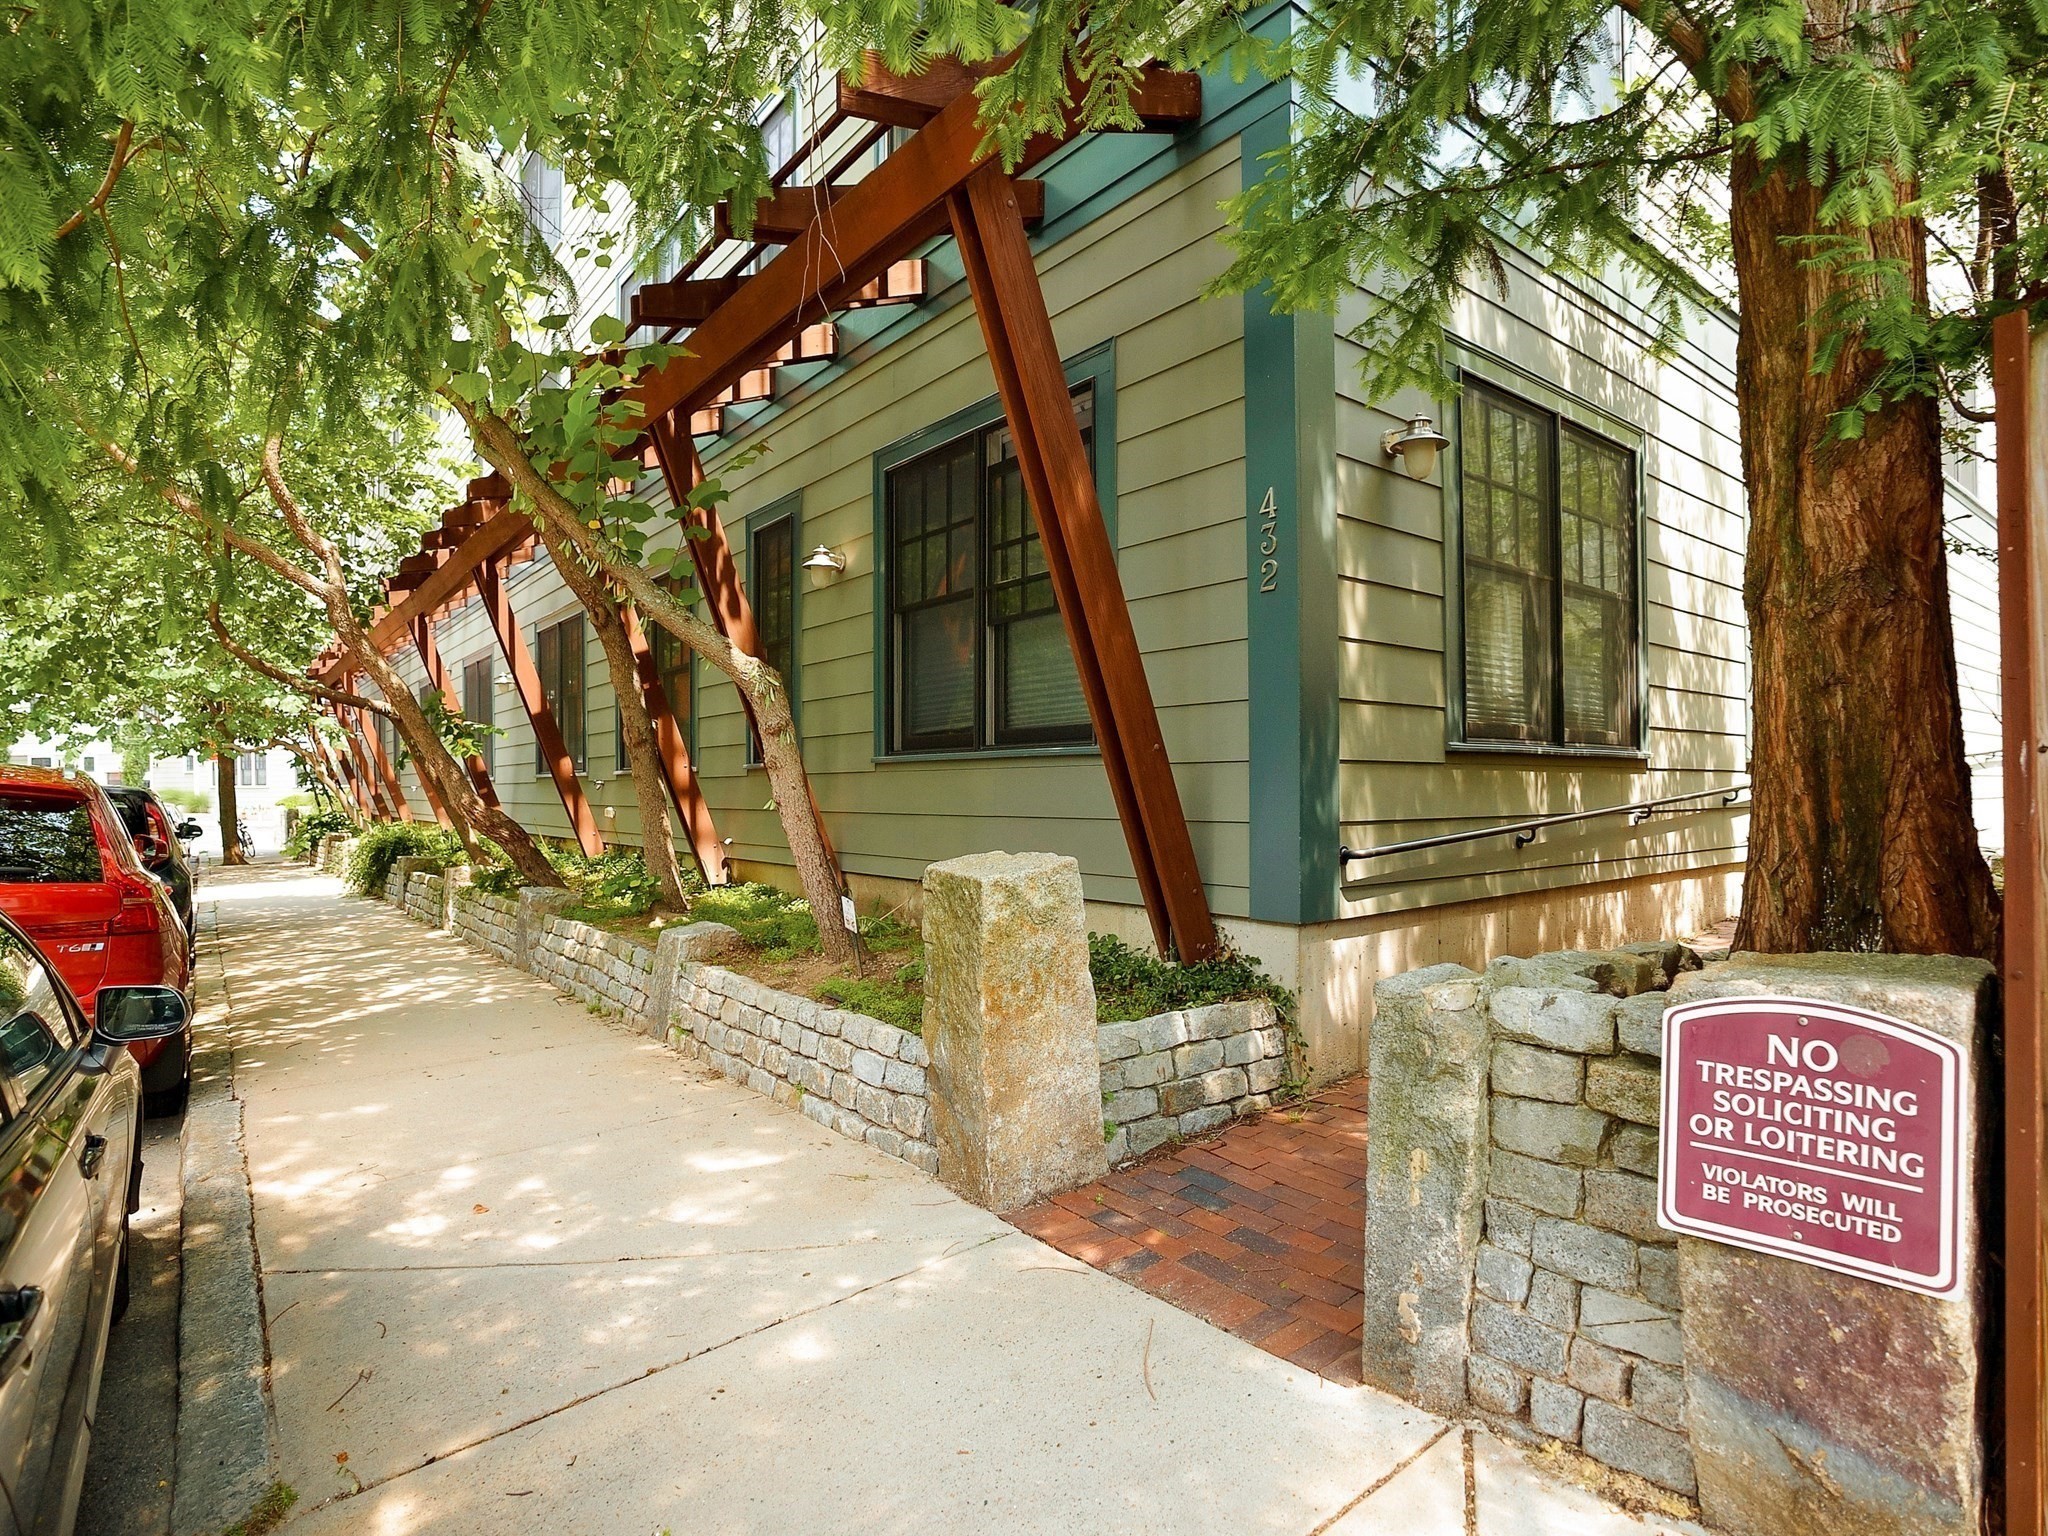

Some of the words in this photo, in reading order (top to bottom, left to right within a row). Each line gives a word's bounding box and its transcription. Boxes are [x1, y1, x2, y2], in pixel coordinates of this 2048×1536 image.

[1258, 486, 1279, 593] 432
[1766, 1033, 1839, 1073] NO
[1695, 1059, 1919, 1117] TRESPASSING
[1712, 1090, 1897, 1143] SOLICITING
[1688, 1113, 1735, 1142] OR
[1744, 1122, 1926, 1179] LOITERING
[1701, 1162, 1828, 1204] VIOLATORS
[1841, 1191, 1904, 1223] WILL
[1701, 1182, 1731, 1205] BE
[1742, 1193, 1903, 1243] PROSECUTED
